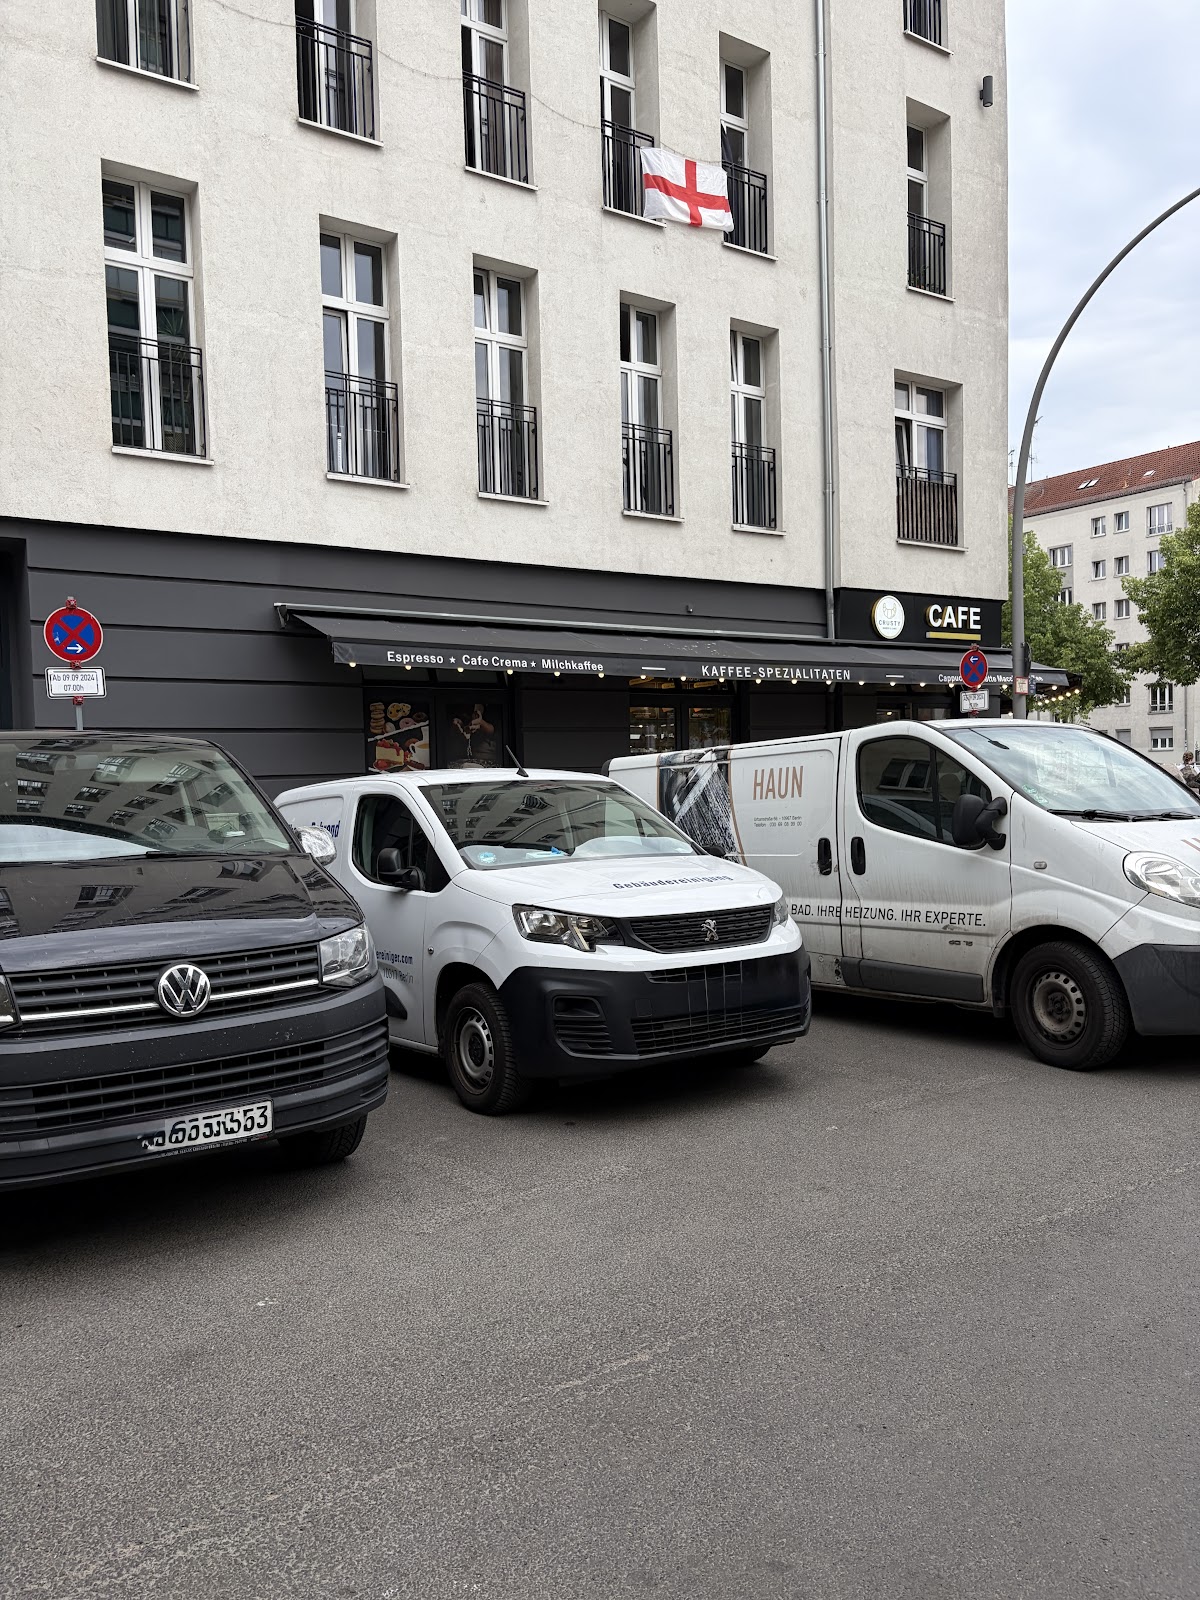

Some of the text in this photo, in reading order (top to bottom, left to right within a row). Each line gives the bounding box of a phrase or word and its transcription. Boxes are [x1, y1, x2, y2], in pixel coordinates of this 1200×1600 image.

[878, 619, 901, 627] CRUSTY
[927, 604, 982, 630] CAFE
[387, 651, 604, 671] Espresso Cafe Crema Milchkaffee
[753, 765, 804, 800] HAUN
[612, 874, 735, 890] Gebäudereinigung
[791, 904, 987, 927] BAD. IHRE HEIZUNG. IHR EXPERTE.
[376, 949, 413, 965] ereiniger.com
